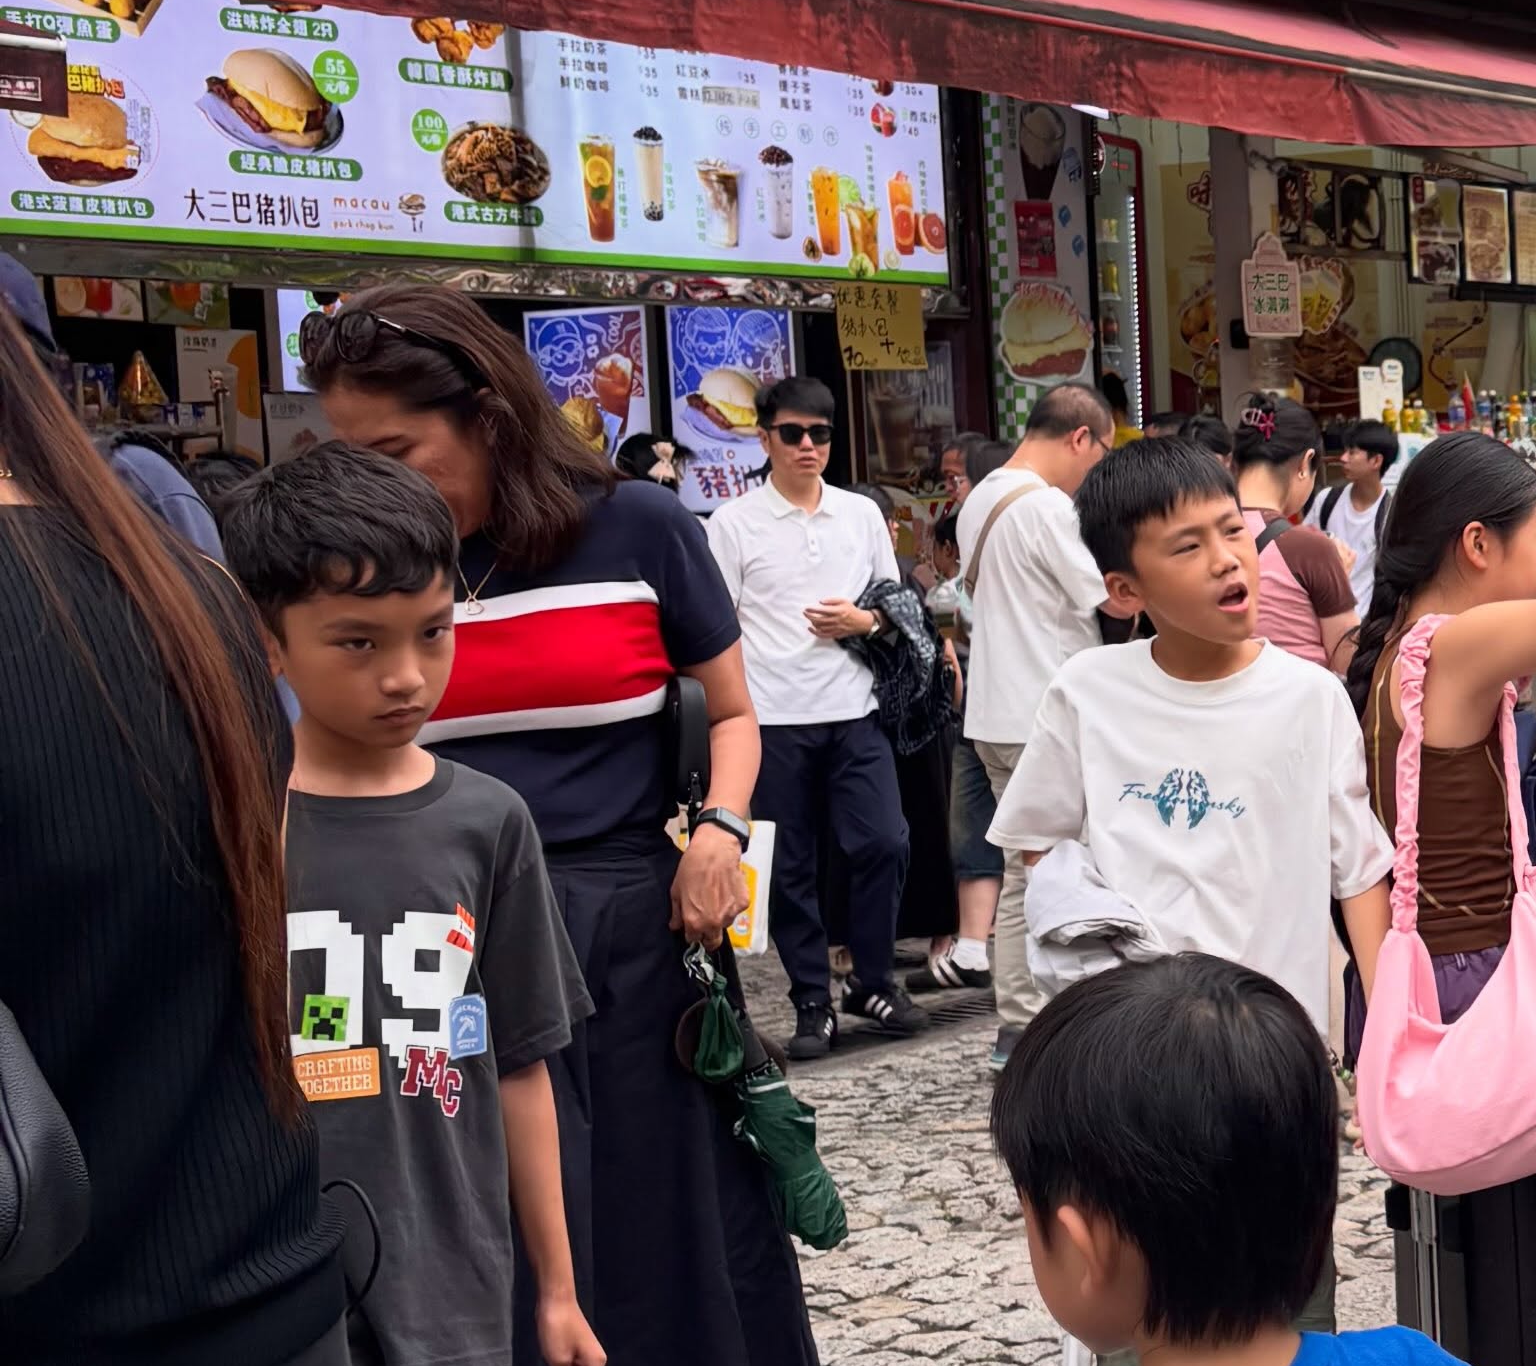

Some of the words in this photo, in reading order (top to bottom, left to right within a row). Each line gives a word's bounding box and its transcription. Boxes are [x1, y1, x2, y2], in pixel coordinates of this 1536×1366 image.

[325, 58, 346, 75] 55
[333, 196, 390, 212] macau
[1252, 273, 1289, 292] 大三巴
[297, 1054, 373, 1078] CRAFTING
